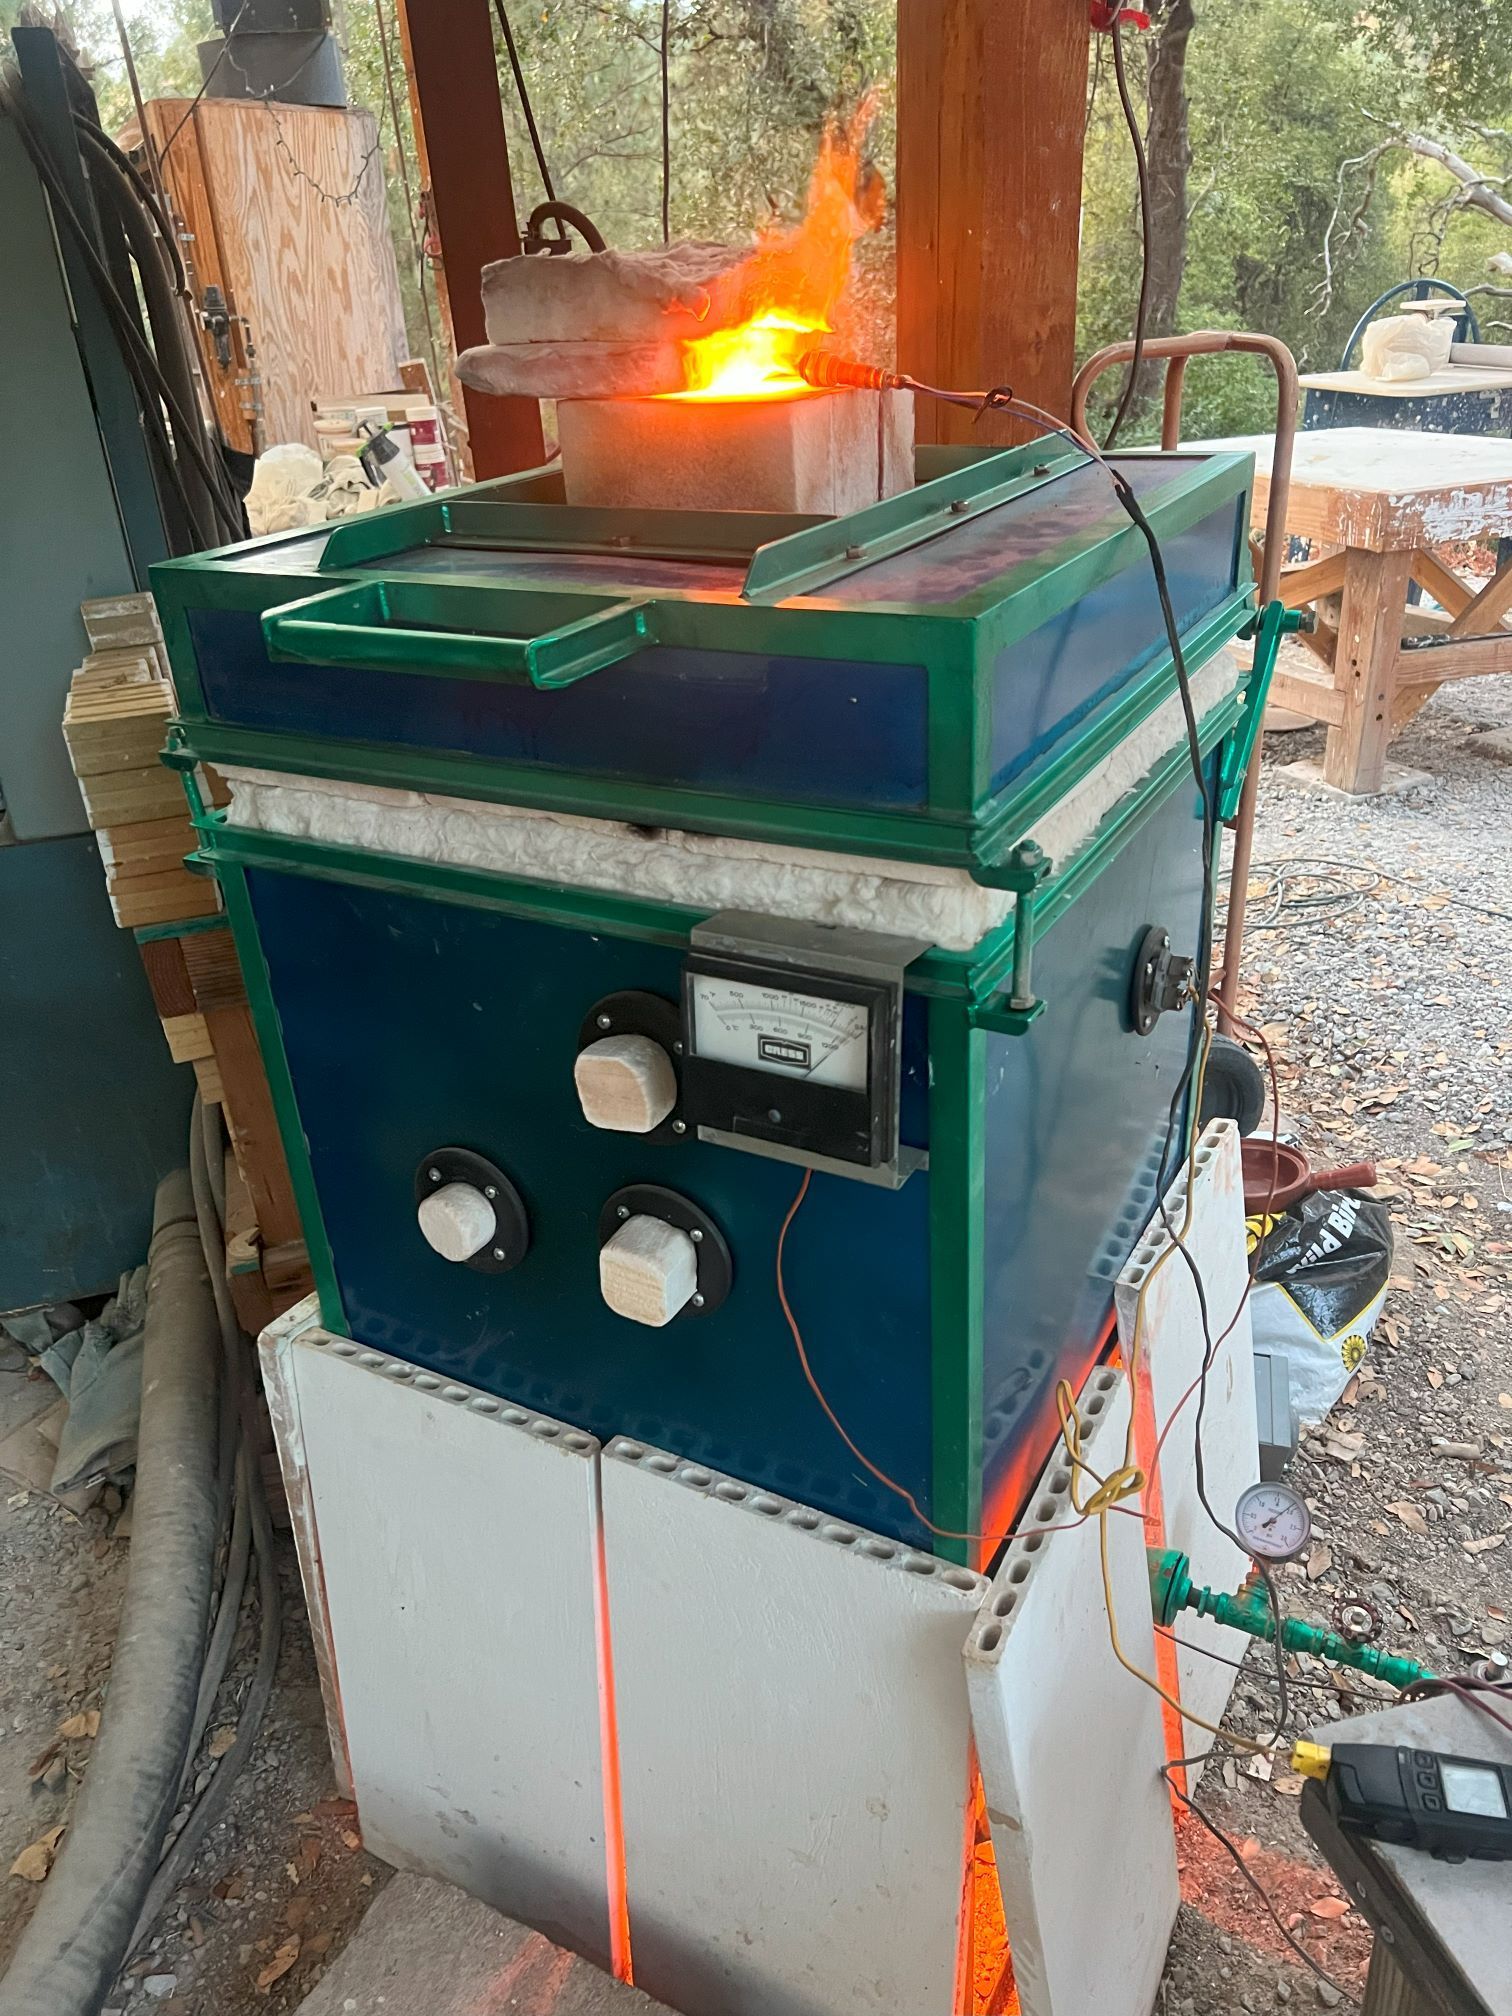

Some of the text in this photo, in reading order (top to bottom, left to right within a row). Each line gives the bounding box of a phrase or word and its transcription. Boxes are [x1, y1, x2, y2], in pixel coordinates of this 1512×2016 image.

[729, 990, 744, 998] 500
[762, 992, 779, 1001] 1000
[800, 1000, 817, 1009] 1500
